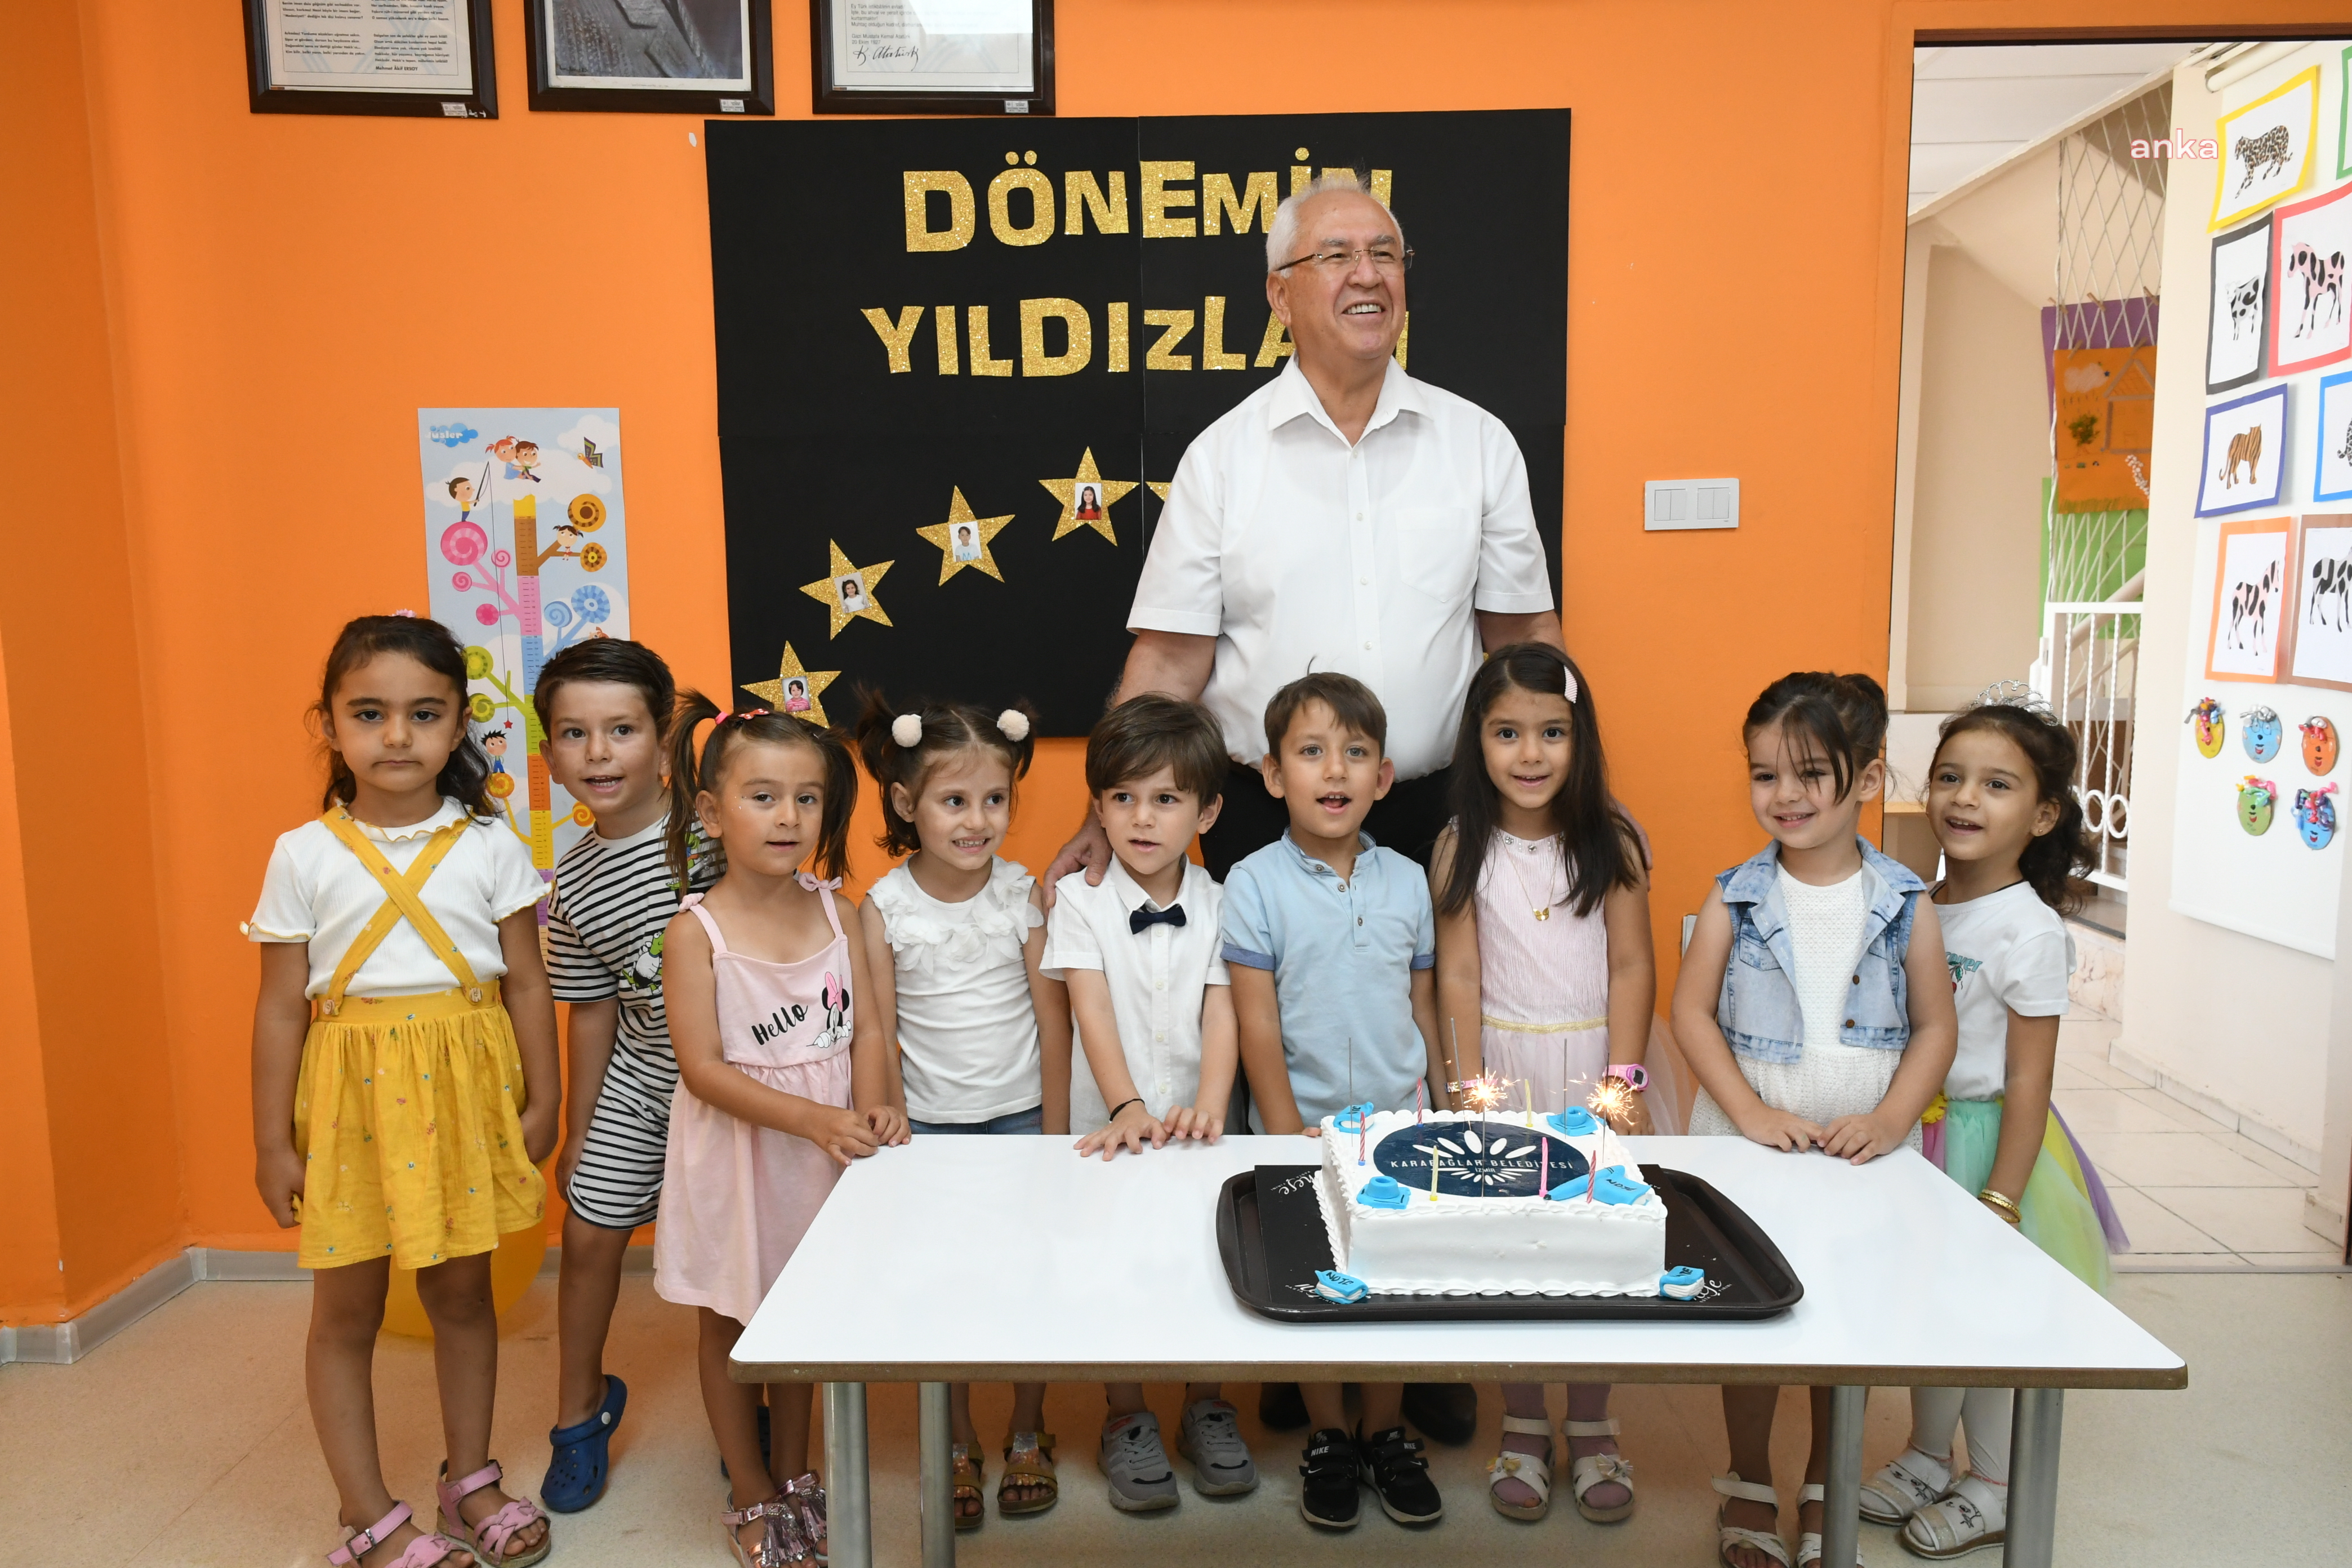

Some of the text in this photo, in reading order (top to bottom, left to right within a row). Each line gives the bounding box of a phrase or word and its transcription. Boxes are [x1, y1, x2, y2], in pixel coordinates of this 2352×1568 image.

[861, 296, 1409, 378] YILDIZLAI
[751, 1004, 808, 1046] Hello
[1391, 1158, 1573, 1169] KARABAĞLAR BELEDİESİ
[1311, 1446, 1330, 1456] NIKE
